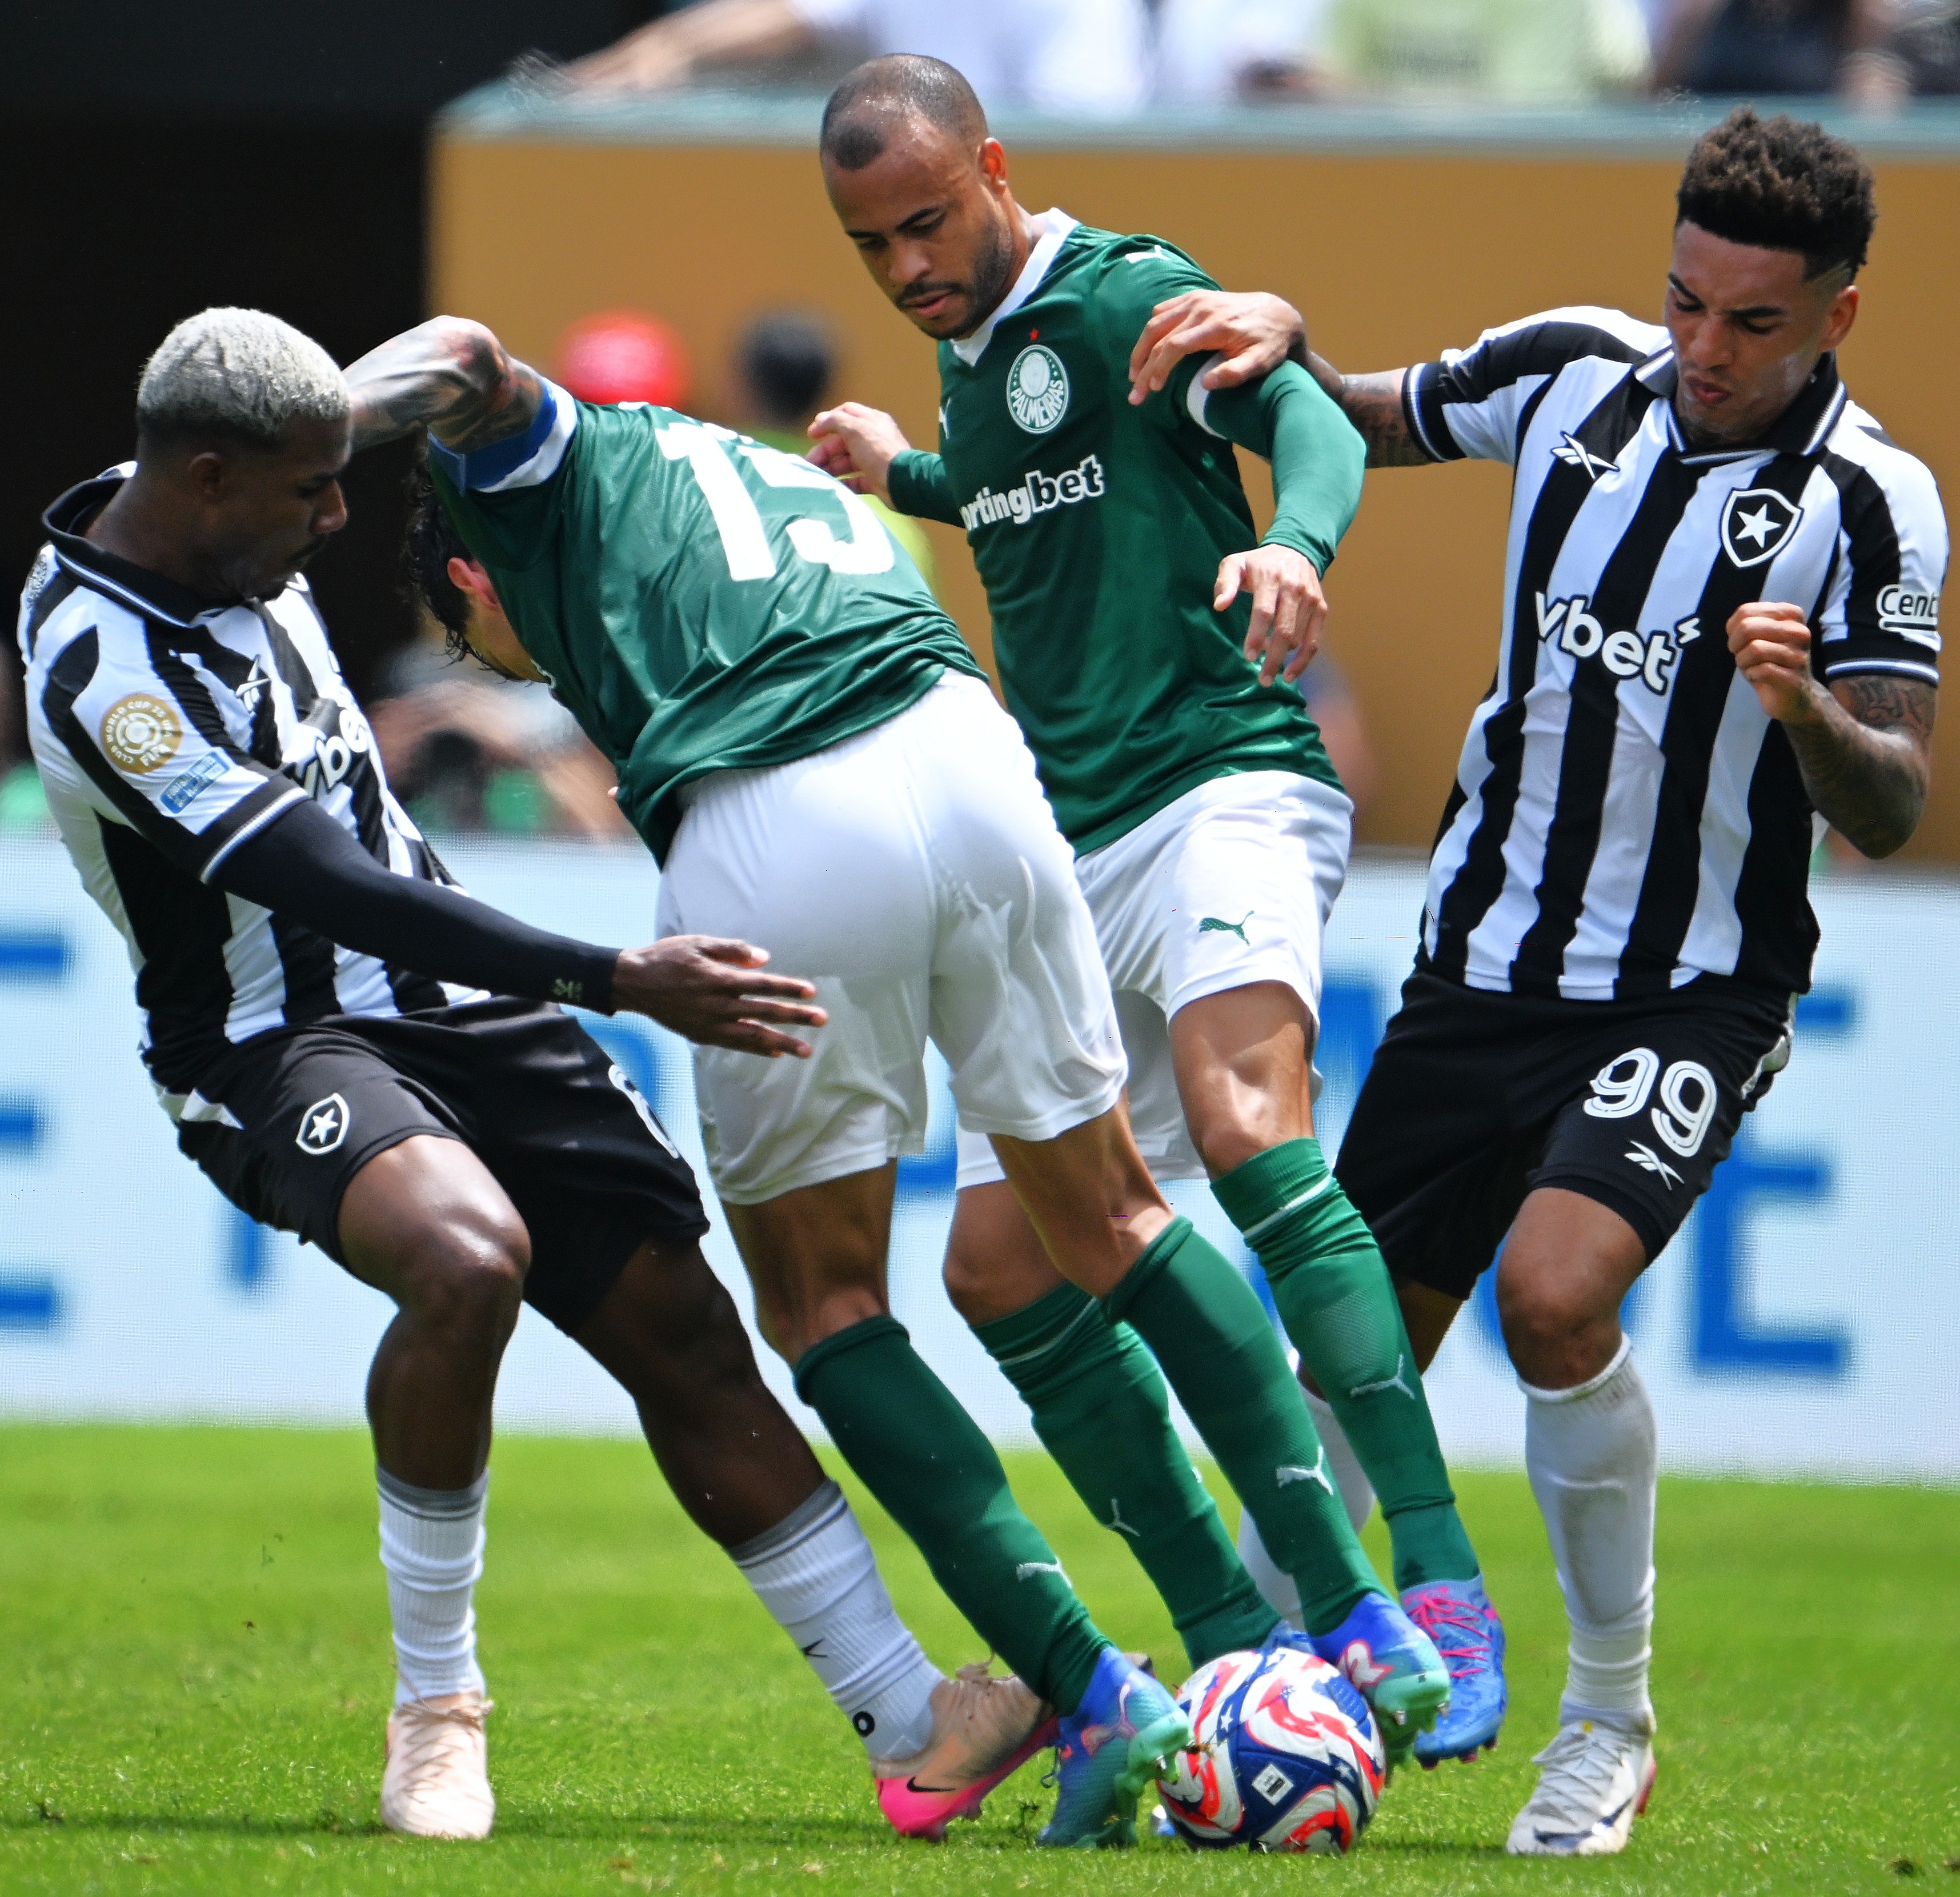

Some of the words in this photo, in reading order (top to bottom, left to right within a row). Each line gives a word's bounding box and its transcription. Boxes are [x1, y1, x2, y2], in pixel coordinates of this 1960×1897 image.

[1010, 379, 1064, 428] PALMEIRAS
[654, 422, 895, 582] 15
[1534, 590, 1673, 692] vbet
[105, 706, 127, 743] WORLD
[127, 700, 153, 710] CUP
[110, 745, 135, 764] CLUB
[1582, 1046, 1718, 1158] 99
